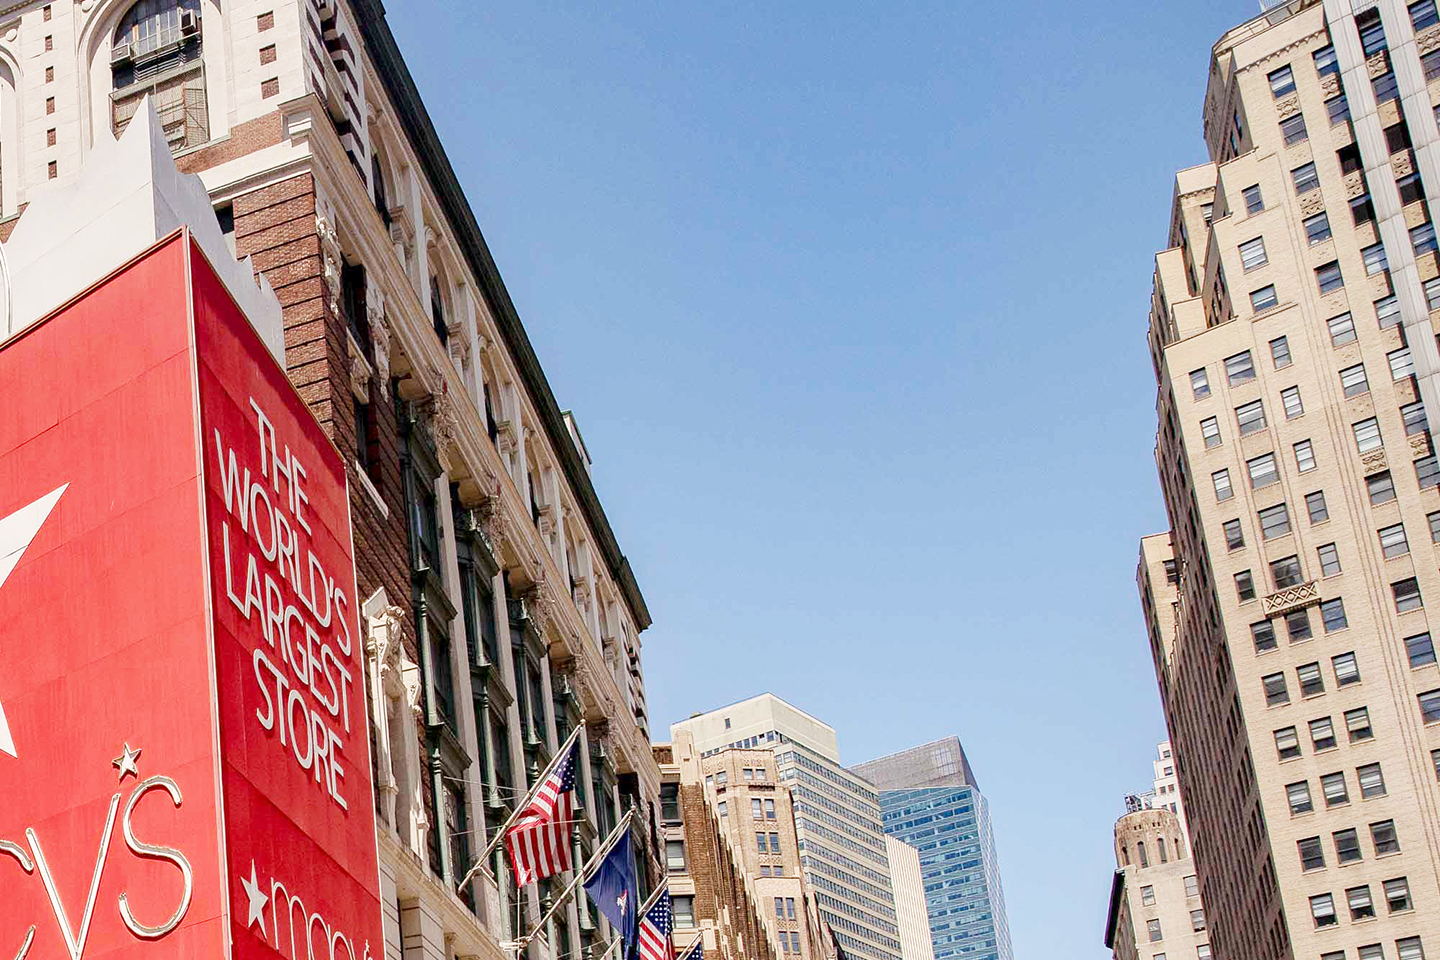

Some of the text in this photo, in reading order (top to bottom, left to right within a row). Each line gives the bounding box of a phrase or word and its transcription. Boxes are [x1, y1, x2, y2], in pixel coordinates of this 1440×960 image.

[215, 428, 352, 657] WORLD'S
[250, 396, 312, 537] THE
[222, 521, 352, 734] LARGEST
[253, 648, 348, 810] STORE
